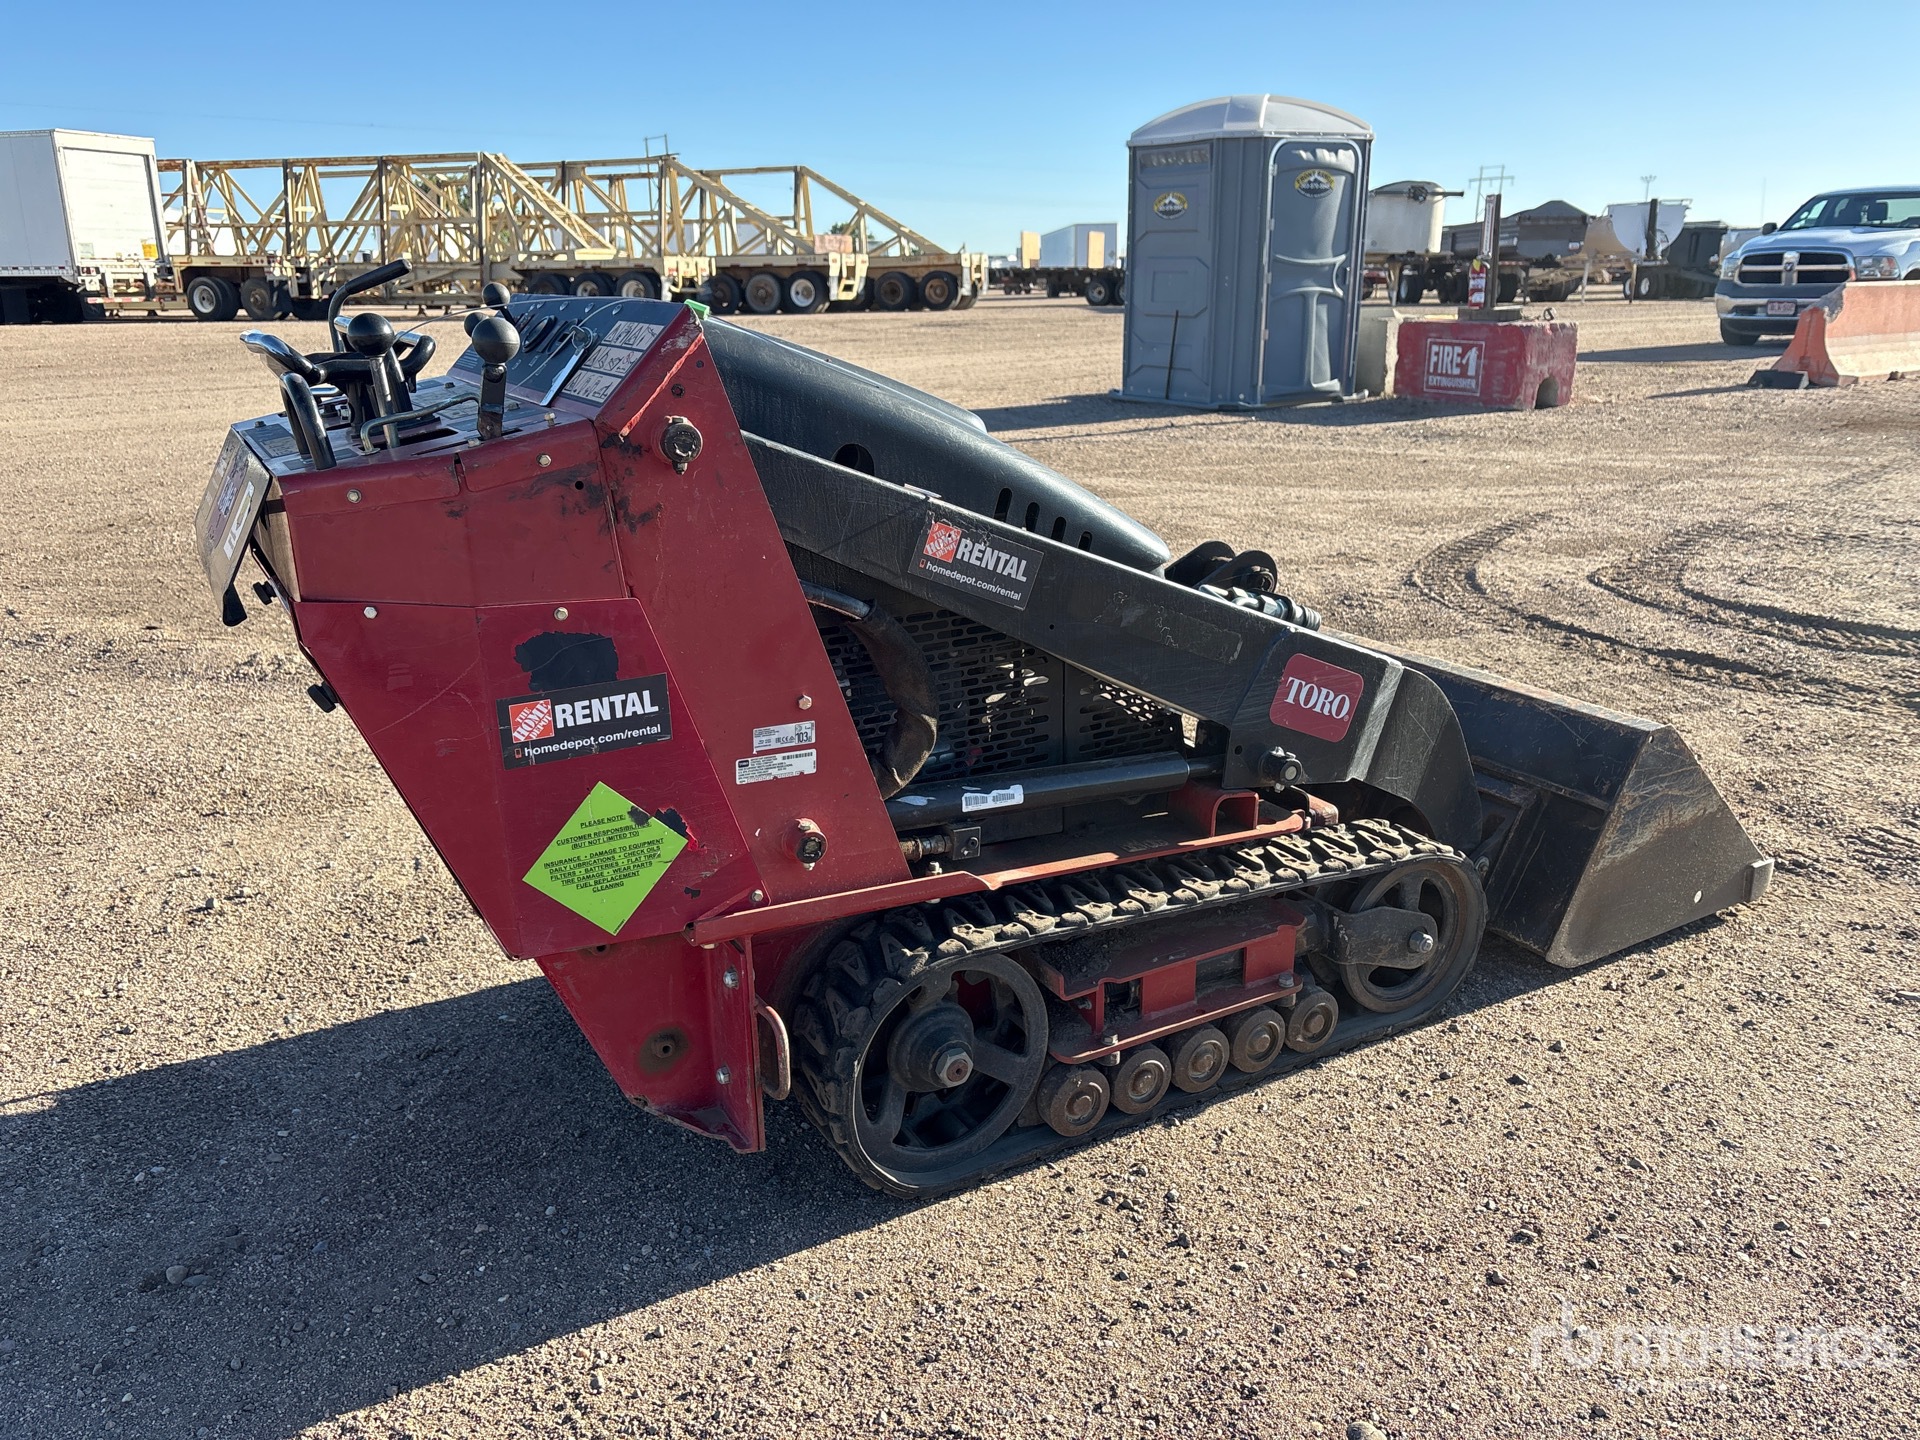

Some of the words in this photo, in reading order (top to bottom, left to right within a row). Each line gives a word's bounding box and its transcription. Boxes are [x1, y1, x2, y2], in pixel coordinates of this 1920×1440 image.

[1429, 344, 1463, 375] FIRE
[956, 538, 1028, 582] RENTAL
[925, 561, 1022, 601] homedepot.com/rental
[554, 689, 659, 729] RENTAL
[1284, 676, 1350, 719] TORO
[513, 700, 551, 742] HOME
[515, 706, 532, 724] THE
[528, 714, 553, 740] DEPOT
[524, 723, 661, 757] homedepot.com/rental
[580, 817, 605, 828] PLEASE
[606, 814, 626, 823] NOTE:
[556, 833, 592, 846] CUSTOMER
[571, 841, 586, 850] (BUT
[588, 838, 601, 847] NOT
[602, 833, 627, 844] LIMITED
[628, 830, 639, 838] TO)
[544, 855, 581, 869] INSURANCE
[589, 848, 617, 858] DAMAGE
[628, 838, 664, 850] EQUIPMENT
[549, 865, 567, 875] DAILY
[569, 855, 616, 871] LUBRICATIONS
[623, 849, 644, 858] CHECK
[645, 846, 661, 854] OILS
[550, 871, 576, 881] FILTERS
[584, 861, 619, 874] BATTERIES
[626, 856, 642, 864] FLAT
[561, 878, 575, 886] TIRE
[576, 871, 605, 882] DAMAGE
[612, 866, 632, 874] WEAR
[632, 861, 653, 870] PARTS
[576, 881, 592, 890] FUEL
[594, 871, 640, 886] REPLACEMENT
[592, 881, 625, 893] CLEANING
